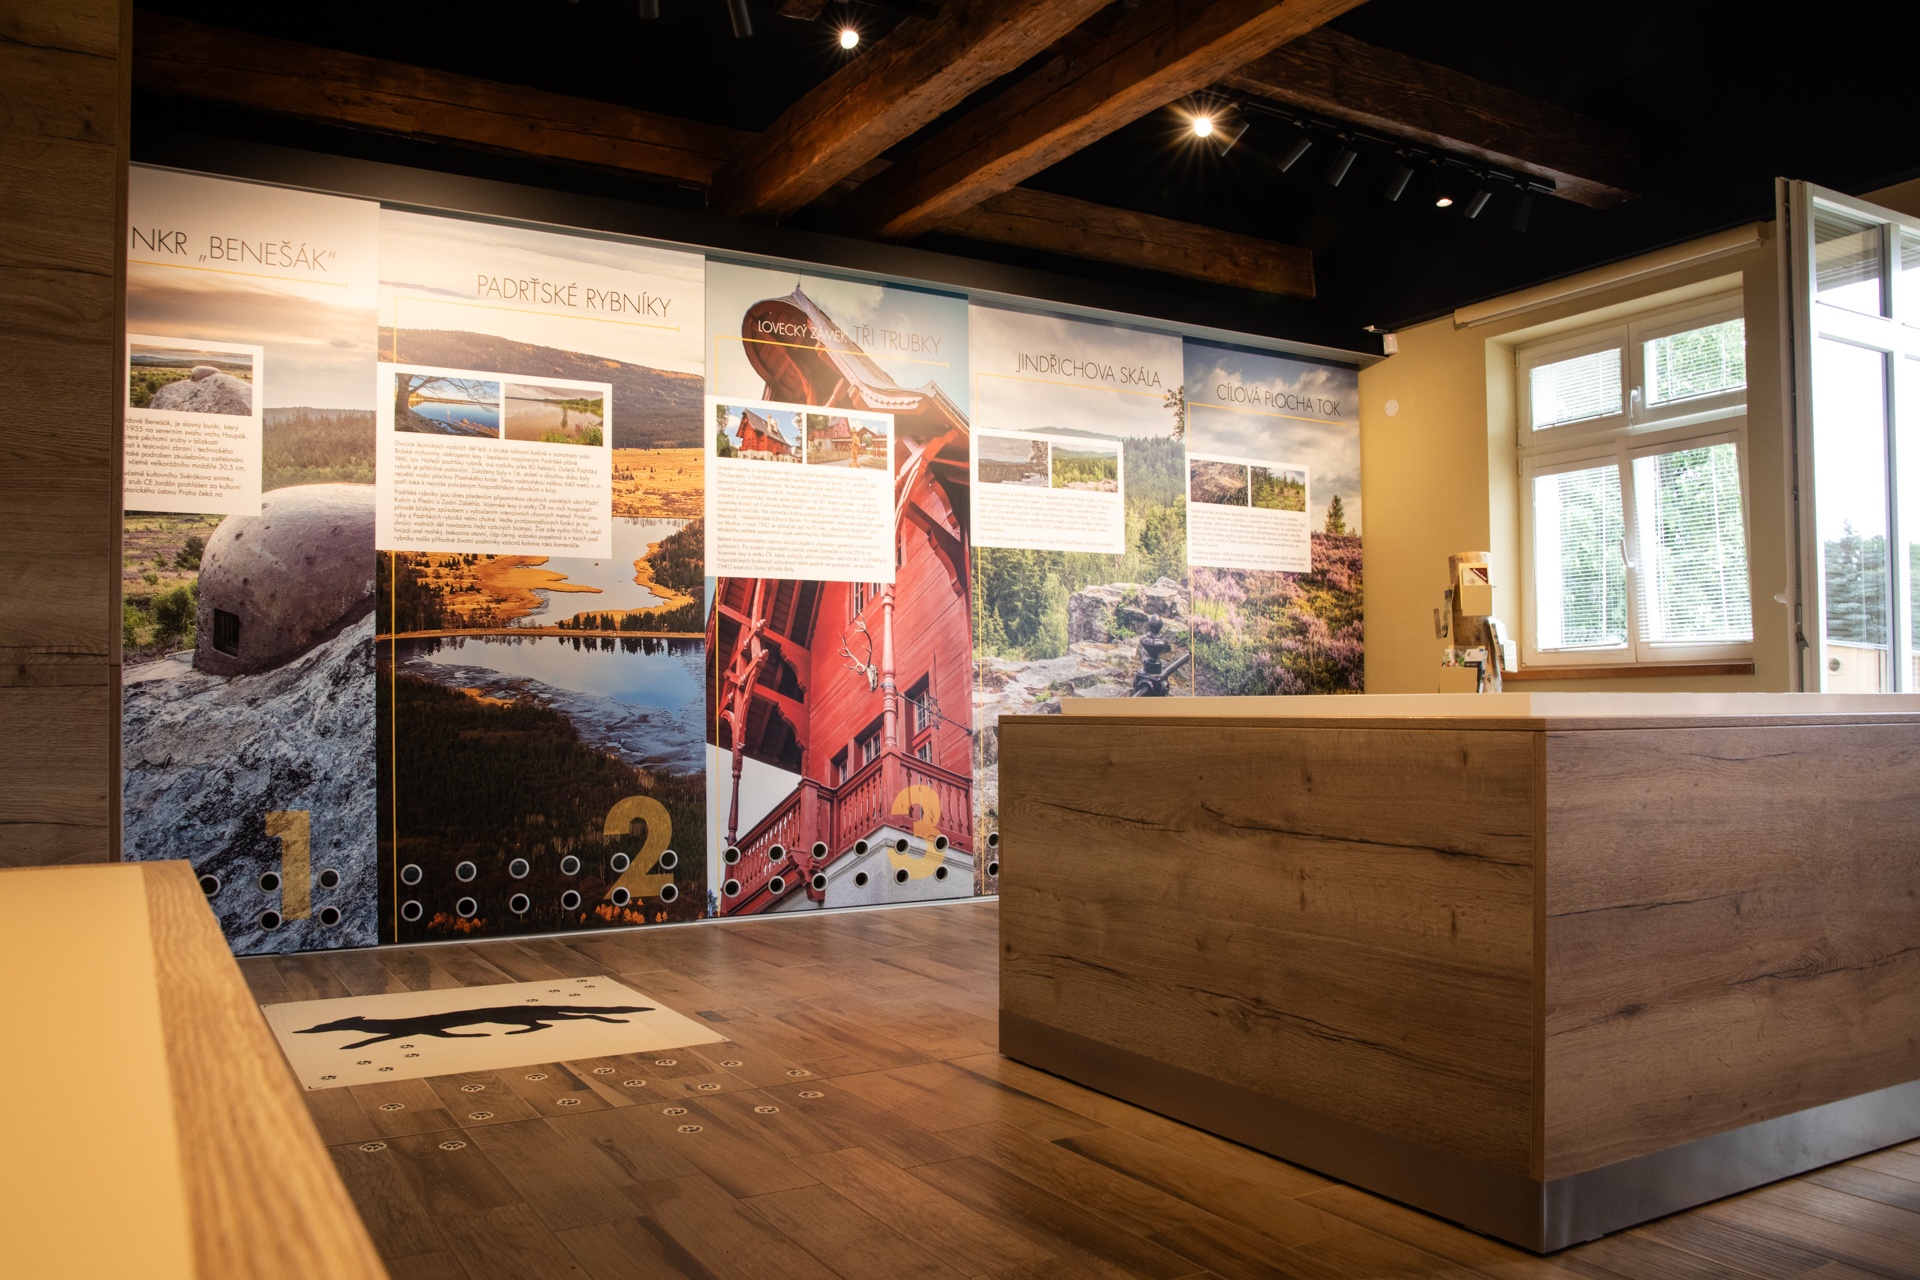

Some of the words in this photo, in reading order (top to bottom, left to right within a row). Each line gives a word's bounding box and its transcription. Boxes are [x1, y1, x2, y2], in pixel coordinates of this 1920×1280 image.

[132, 226, 188, 256] NKR
[477, 274, 578, 307] PADRŤSKÉ
[586, 288, 672, 318] RYBNÍKY
[757, 319, 808, 338] LOVECKÝ
[810, 326, 850, 344] ZÁMEK
[853, 323, 875, 346] TŘI
[880, 329, 942, 354] TRUBKY
[1015, 352, 1116, 382] JINDŘICHOVA
[1120, 366, 1162, 388] SKÁLA
[1216, 382, 1261, 405] CÍLOVÁ
[1264, 390, 1315, 413] PLOCHA
[1317, 398, 1342, 417] TOK
[603, 795, 675, 900] 2
[887, 784, 946, 880] 3
[265, 809, 312, 921] 1
